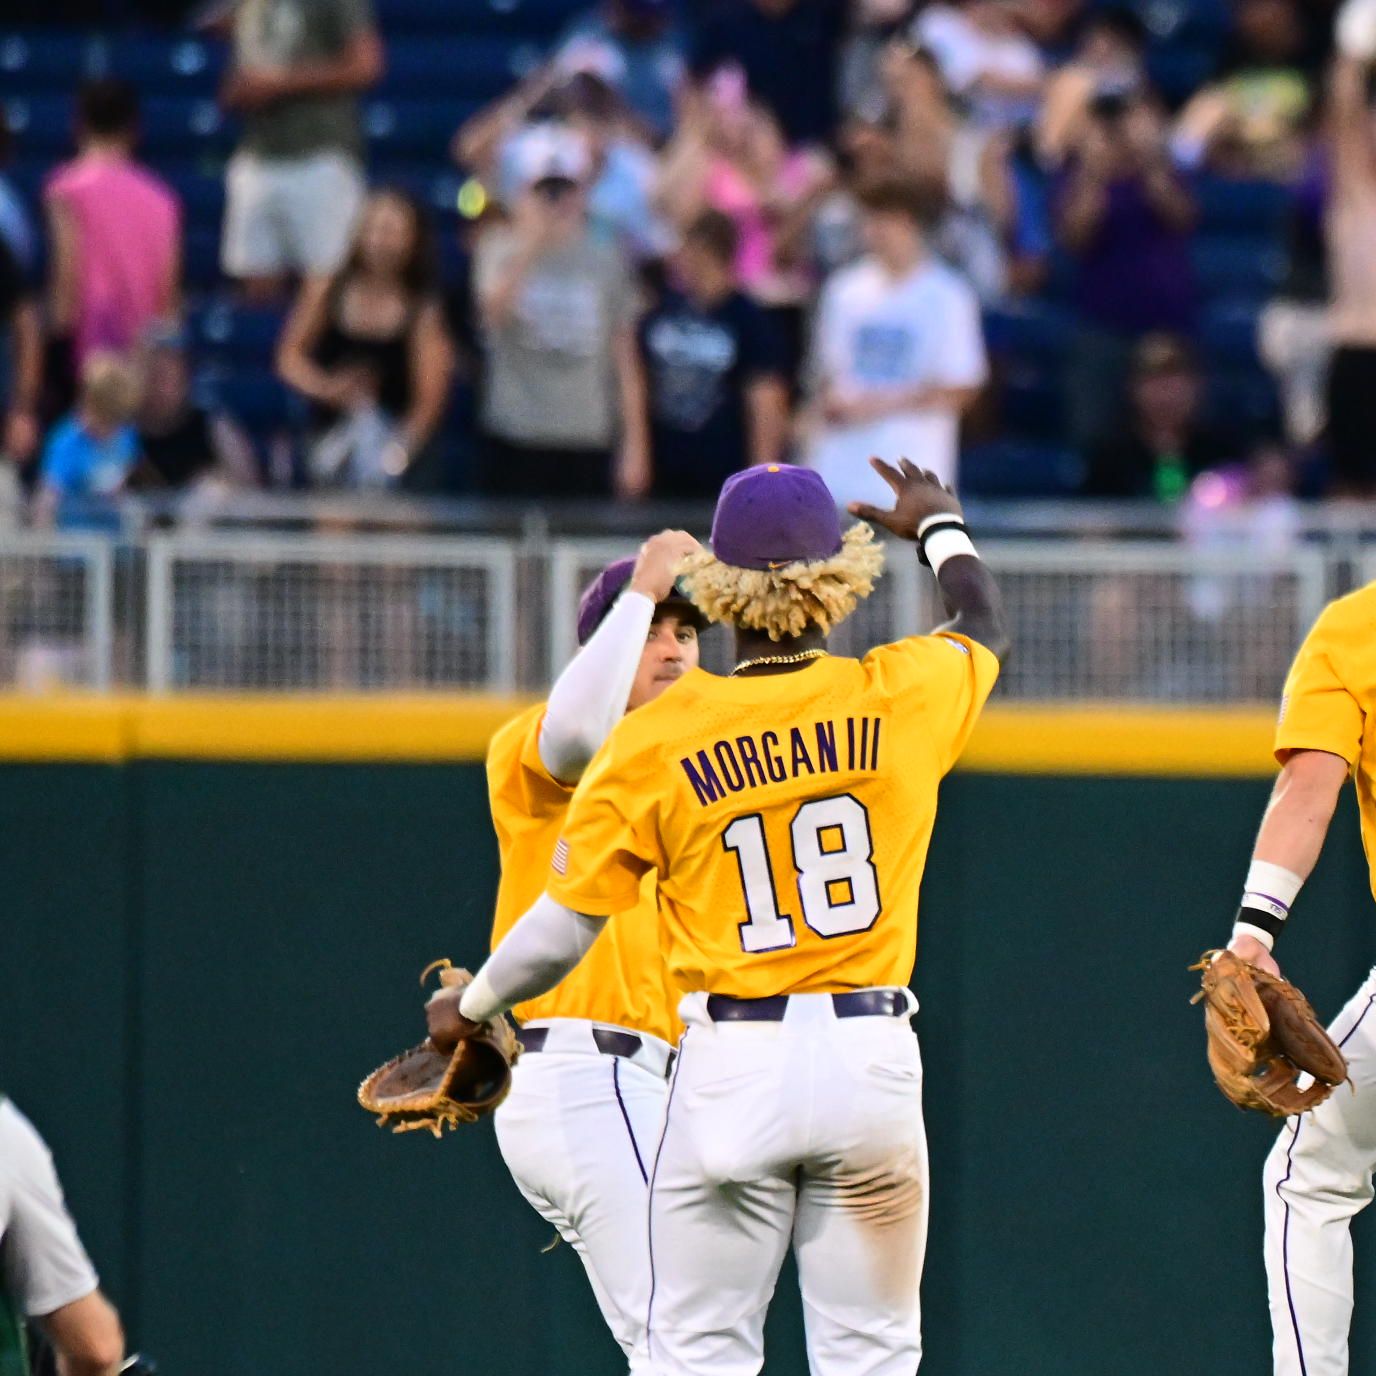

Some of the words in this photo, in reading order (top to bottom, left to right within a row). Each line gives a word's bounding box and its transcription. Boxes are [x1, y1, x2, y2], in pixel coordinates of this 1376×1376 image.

[681, 719, 838, 806] MORGAN
[847, 717, 881, 772] III
[722, 792, 882, 954] 18
